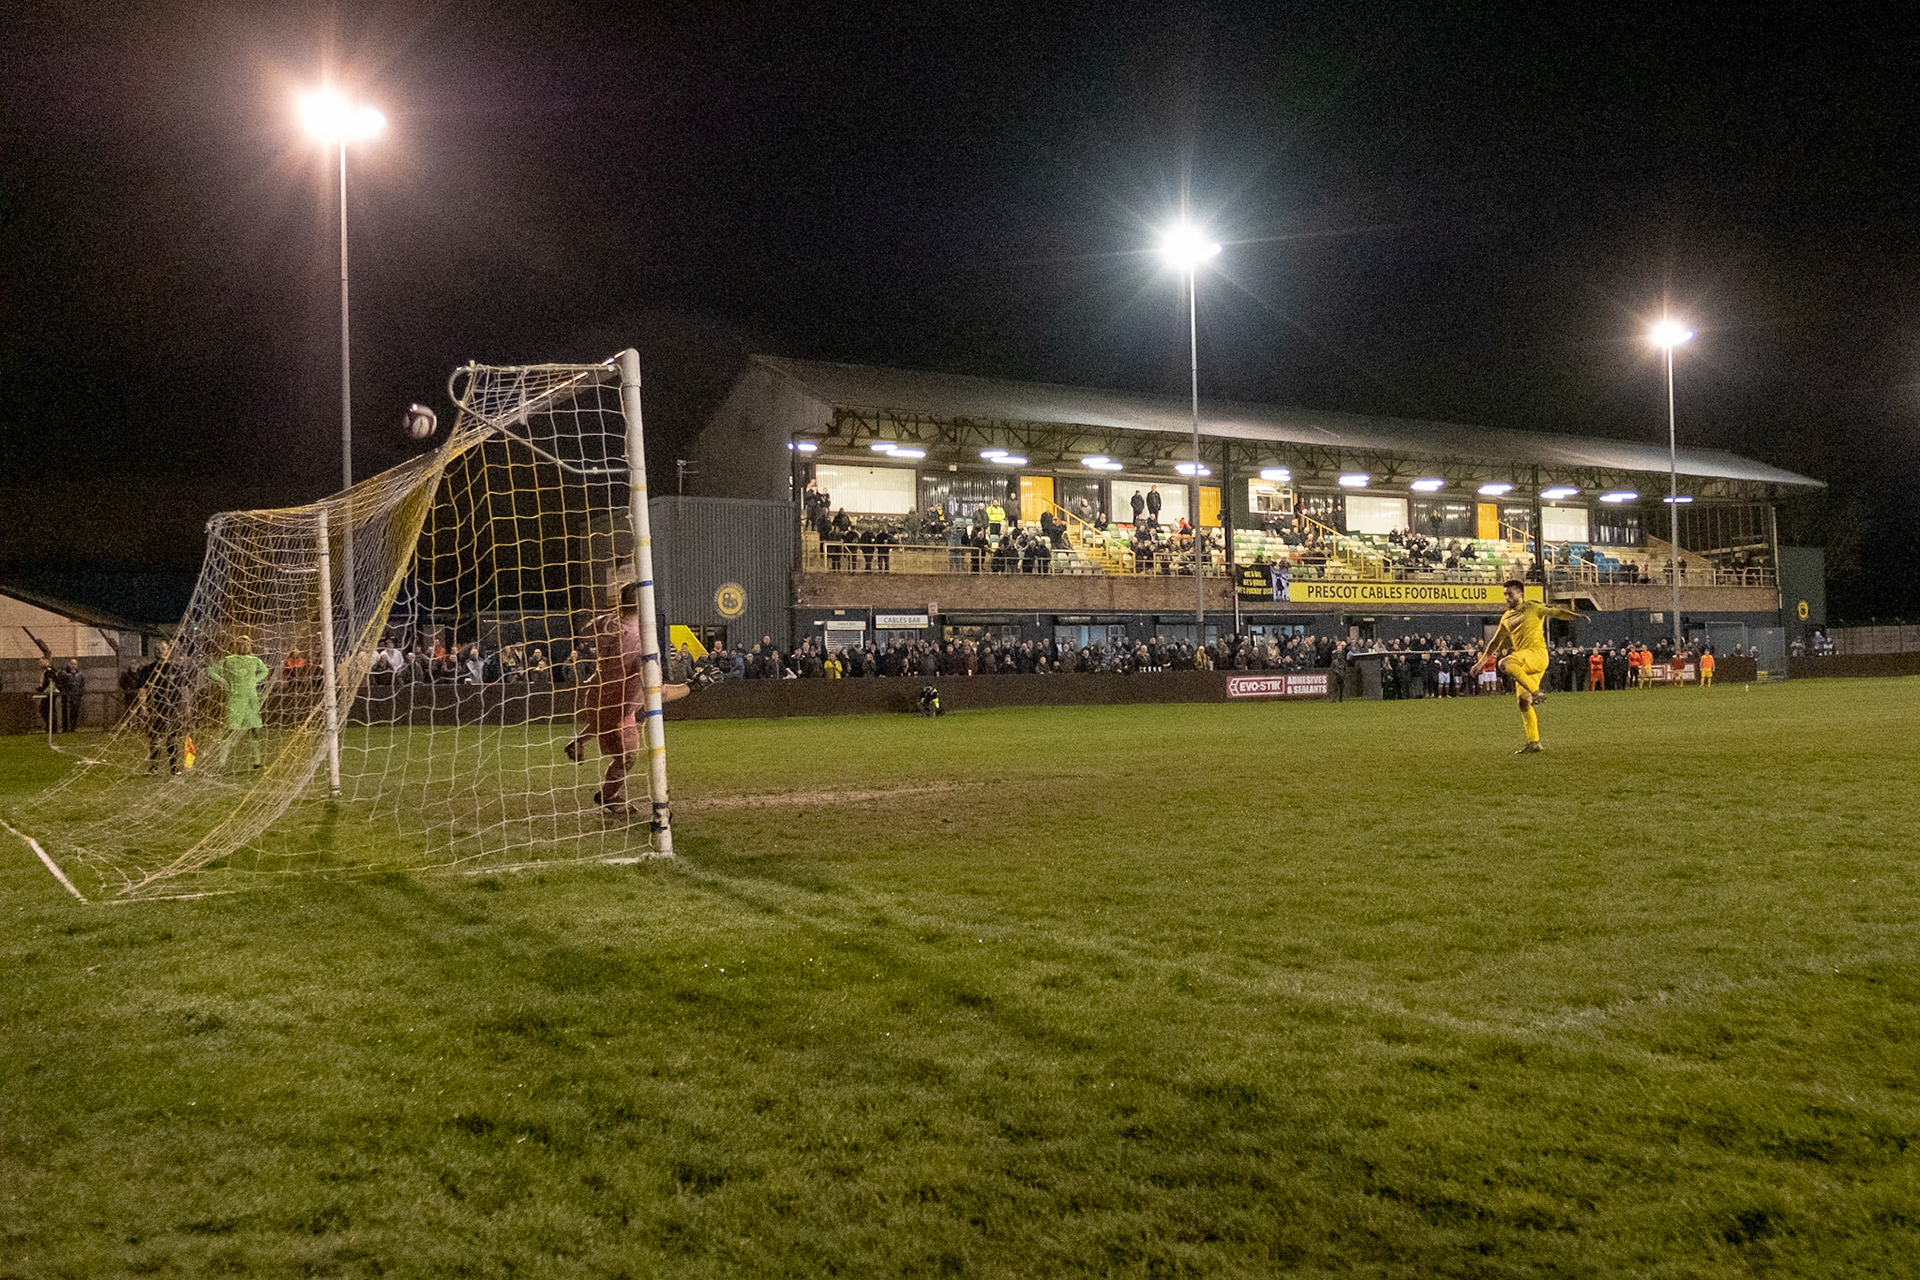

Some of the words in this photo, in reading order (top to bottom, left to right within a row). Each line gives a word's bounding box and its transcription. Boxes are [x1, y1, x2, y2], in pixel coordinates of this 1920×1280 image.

[1307, 585, 1358, 599] PRESCOT
[1361, 585, 1402, 599] CABLES
[1405, 586, 1459, 600] FOOTBALL
[1461, 587, 1487, 600] CLUB
[884, 616, 907, 624] CABLES
[908, 616, 921, 624] BAR
[1287, 675, 1327, 685] ADHESIVES
[1239, 680, 1281, 691] EVO-STIK
[1287, 685, 1292, 694] &
[1293, 685, 1327, 694] SEALANTS
